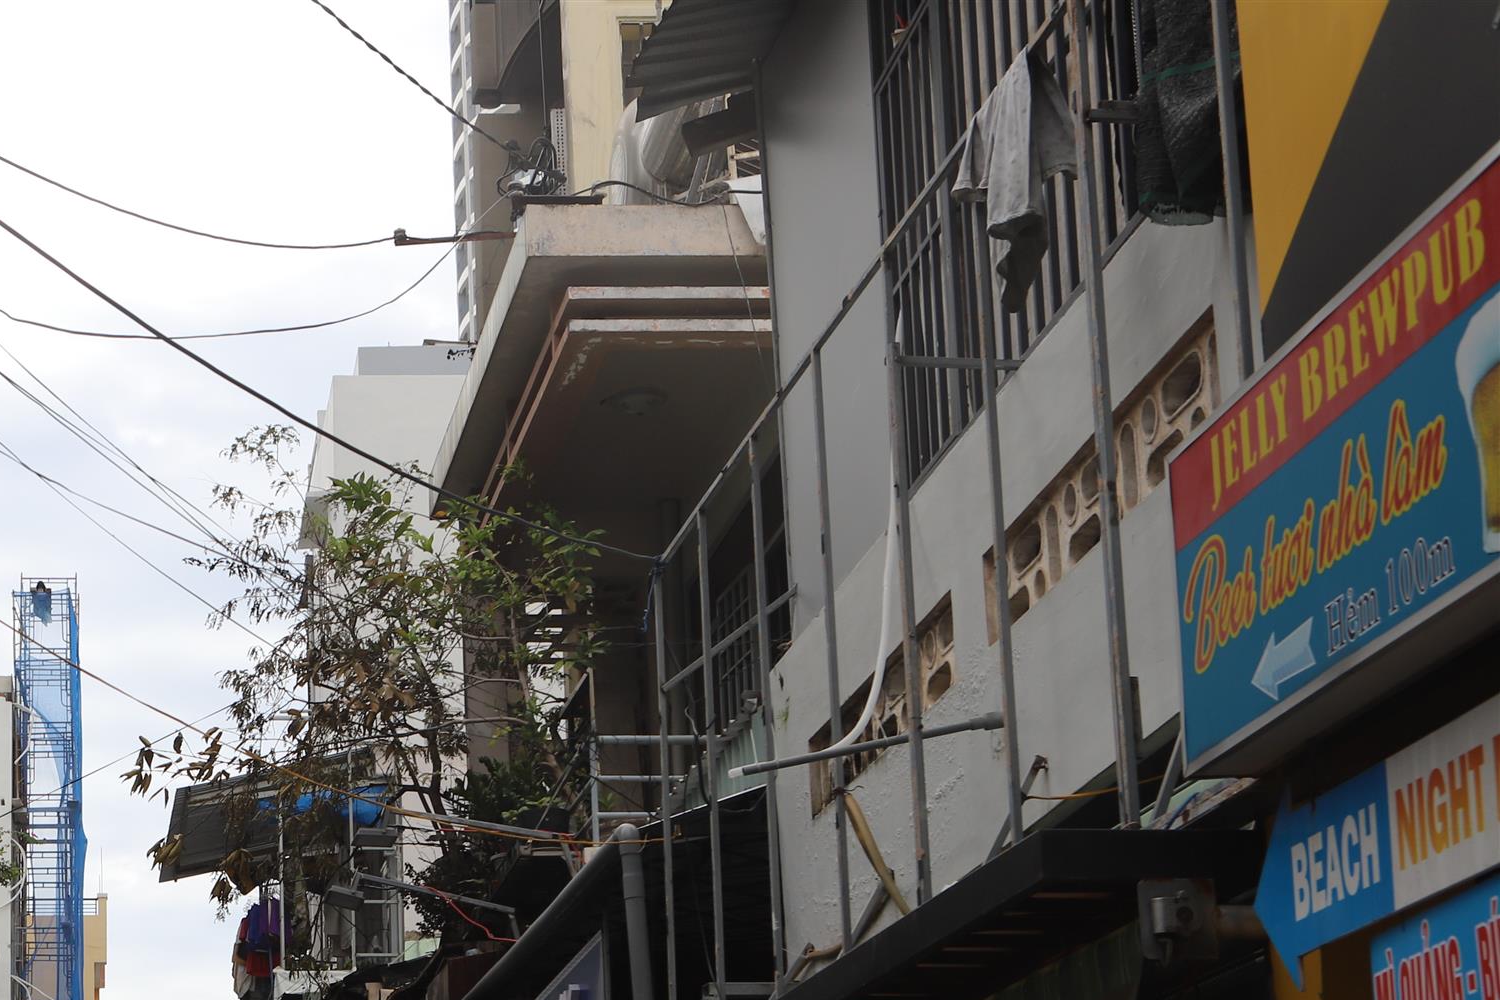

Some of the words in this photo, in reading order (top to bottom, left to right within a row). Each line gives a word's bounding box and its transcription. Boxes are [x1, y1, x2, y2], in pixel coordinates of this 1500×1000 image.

[1208, 373, 1289, 513] JELLY
[1299, 197, 1487, 424] BREWPUB
[1183, 533, 1257, 674] Beer
[1385, 535, 1456, 616] 100m
[1290, 801, 1382, 922] BEACH
[1395, 744, 1485, 871] NIGHT
